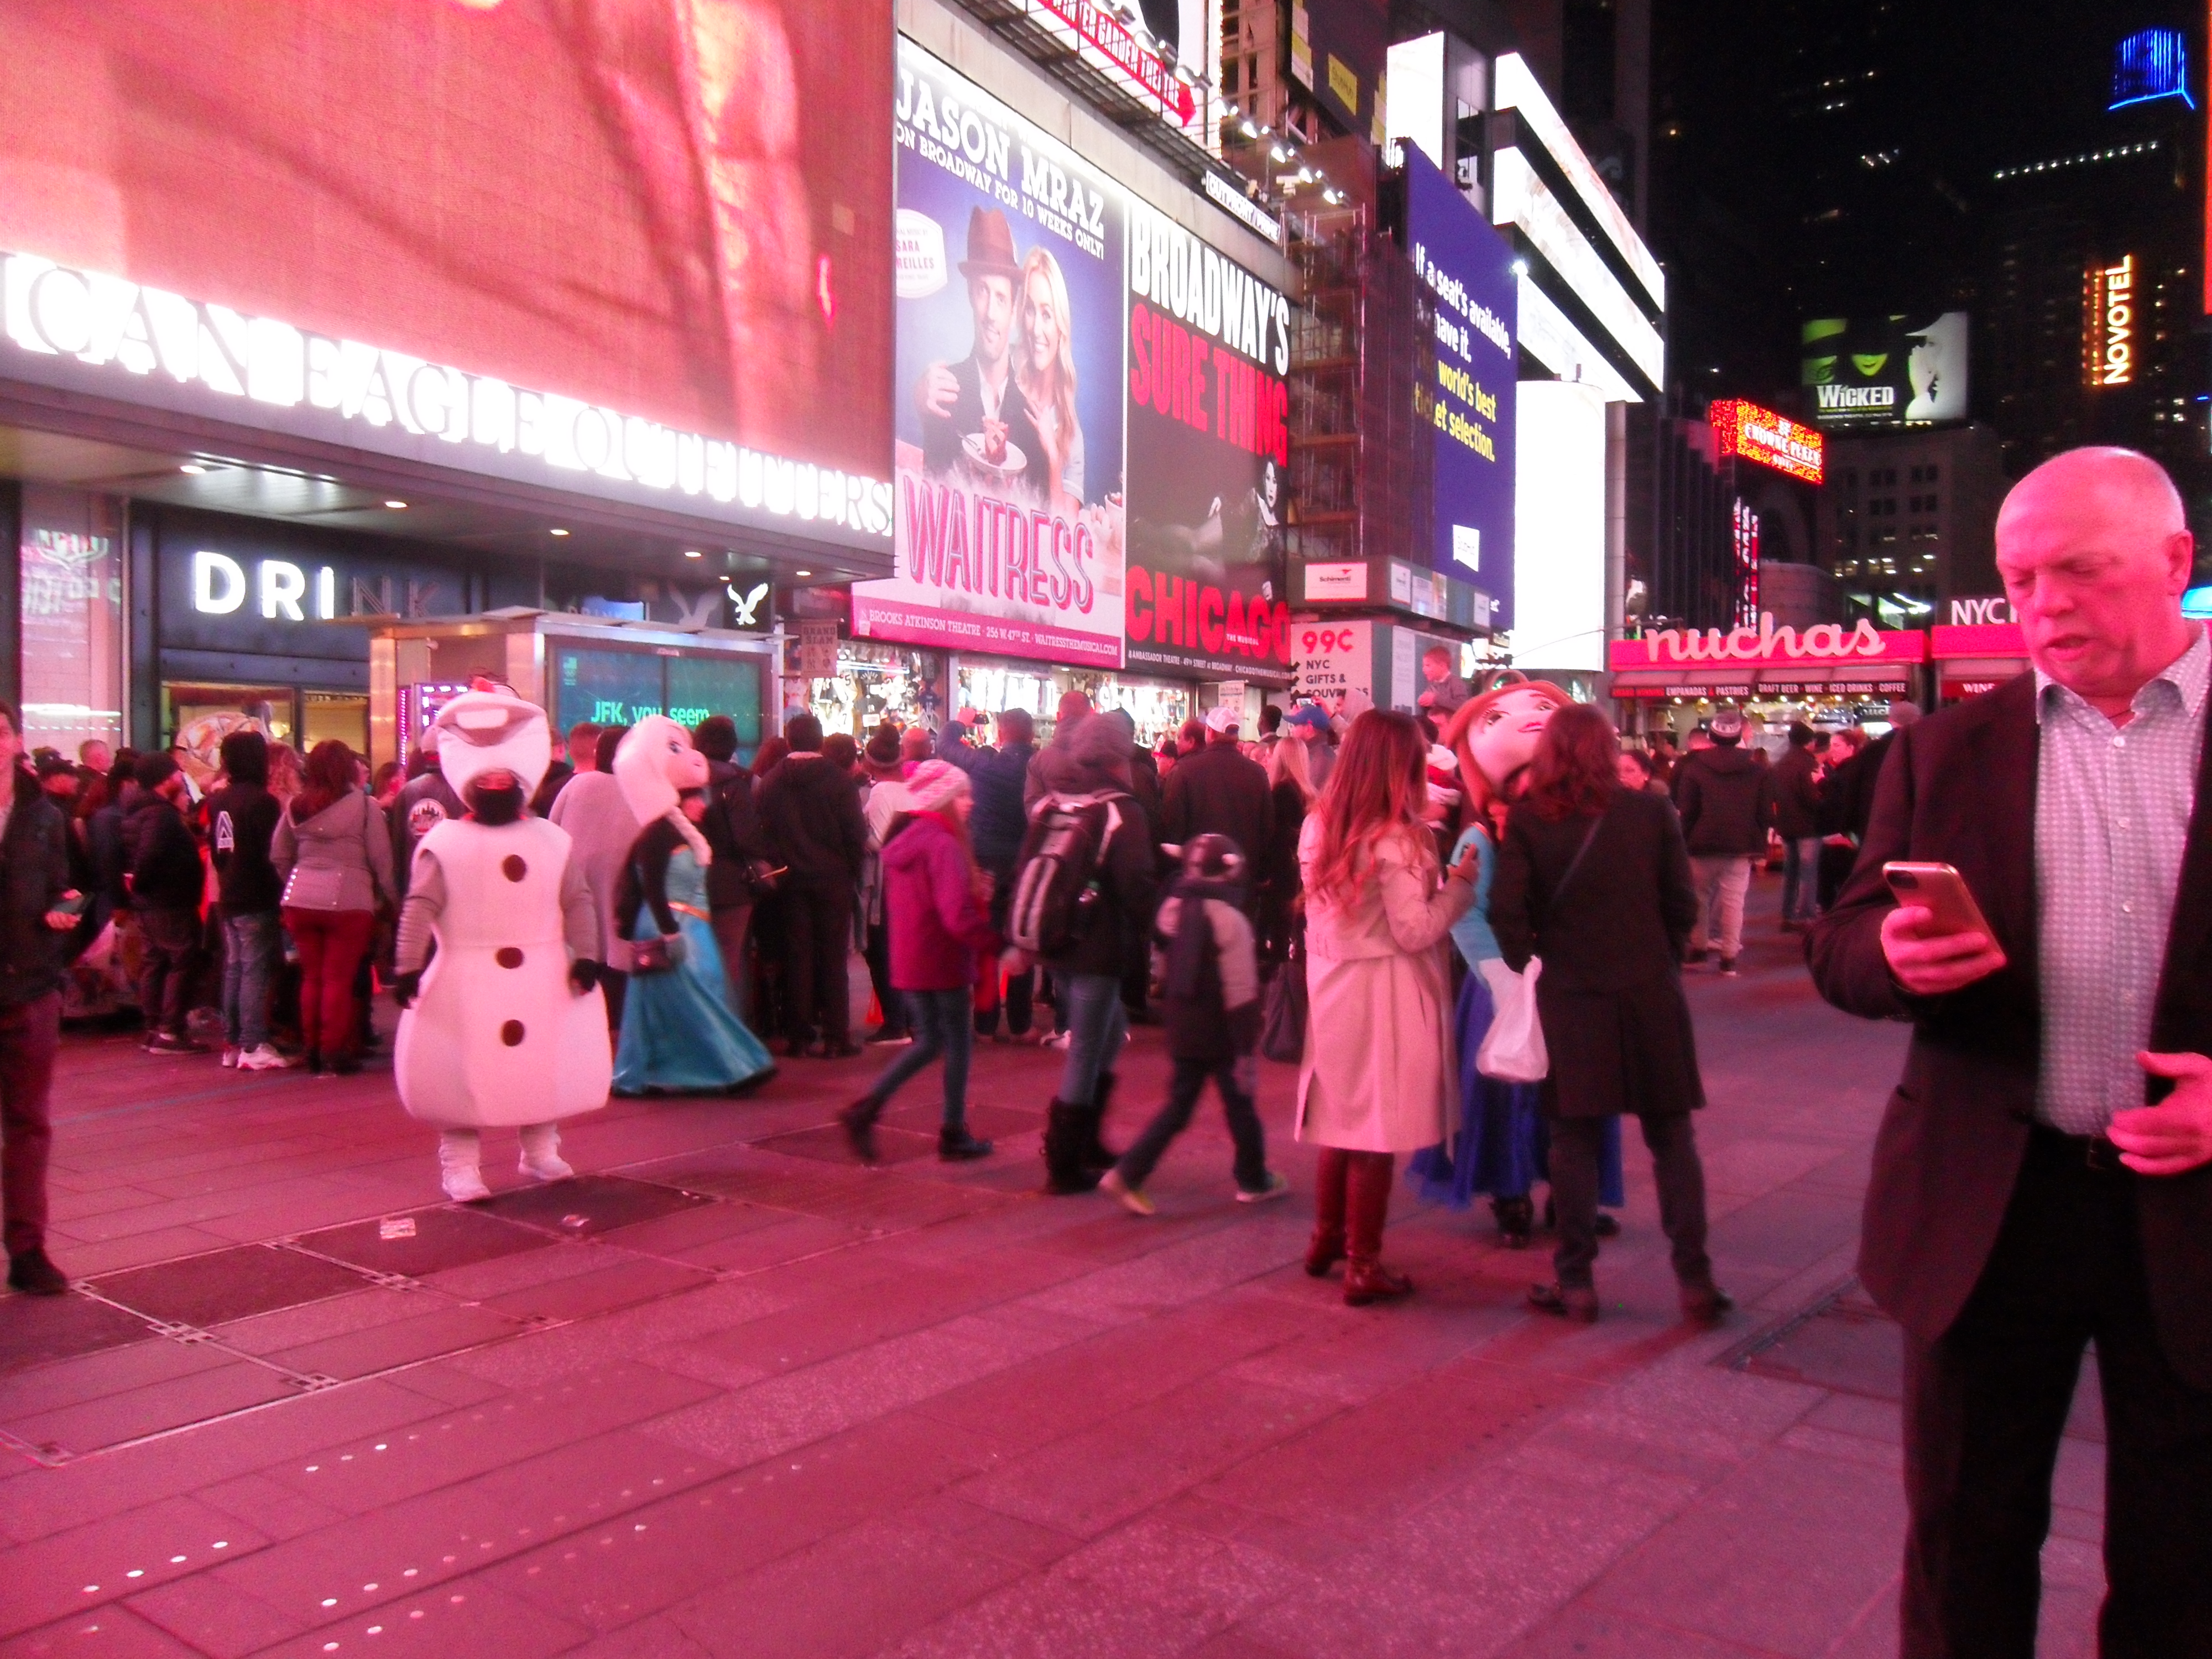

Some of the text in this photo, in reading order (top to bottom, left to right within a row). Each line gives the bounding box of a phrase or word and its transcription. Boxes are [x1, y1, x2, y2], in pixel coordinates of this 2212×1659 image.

[1098, 15, 1138, 75] GARDEN
[896, 69, 1010, 181] JASON
[1021, 144, 1104, 240] MRAZ
[896, 121, 916, 150] ON
[919, 134, 992, 194] BROADWAY
[994, 179, 1019, 210] FOR
[1022, 195, 1034, 218] 10
[1036, 204, 1073, 242] WEEKS
[1075, 228, 1104, 260] ONLY!
[896, 240, 920, 253] SARA
[1131, 202, 1290, 376] BROADWAY'S
[1416, 242, 1425, 278] If
[1427, 261, 1436, 290] a
[1437, 270, 1468, 317] seat's
[1469, 300, 1511, 359] available,
[1460, 326, 1472, 363] it.
[2104, 254, 2131, 384] NOVOTEL
[294, 325, 546, 455] EAGLE
[1130, 302, 1288, 468] SURE THING
[1438, 359, 1496, 423] world's best
[1449, 412, 1495, 463] selection.
[903, 475, 1094, 614] WAITRESS
[869, 609, 903, 625] BROOKS
[905, 614, 946, 631] ATKINSON
[948, 620, 981, 637] THEATRE
[986, 626, 999, 639] 256
[1125, 565, 1291, 664] CHICAGO
[1645, 611, 1886, 662] nuchas
[1951, 597, 2006, 626] NYC
[1132, 650, 1162, 663] AMBASSADOR
[1163, 654, 1180, 665] THEATRE
[1193, 659, 1207, 669] STREET
[1211, 661, 1233, 672] BROADWAY
[1227, 633, 1259, 645] THE MUSICAL
[1306, 660, 1330, 670] NYC
[1306, 674, 1346, 684] GIFTS &
[1758, 682, 1906, 693] DRAFT BEER WINE ICED DRINKS COFFEE
[591, 701, 628, 726] JFK,
[670, 707, 711, 726] seem
[1666, 686, 1707, 696] EMPANADAS
[1715, 686, 1749, 696] PASTRIES
